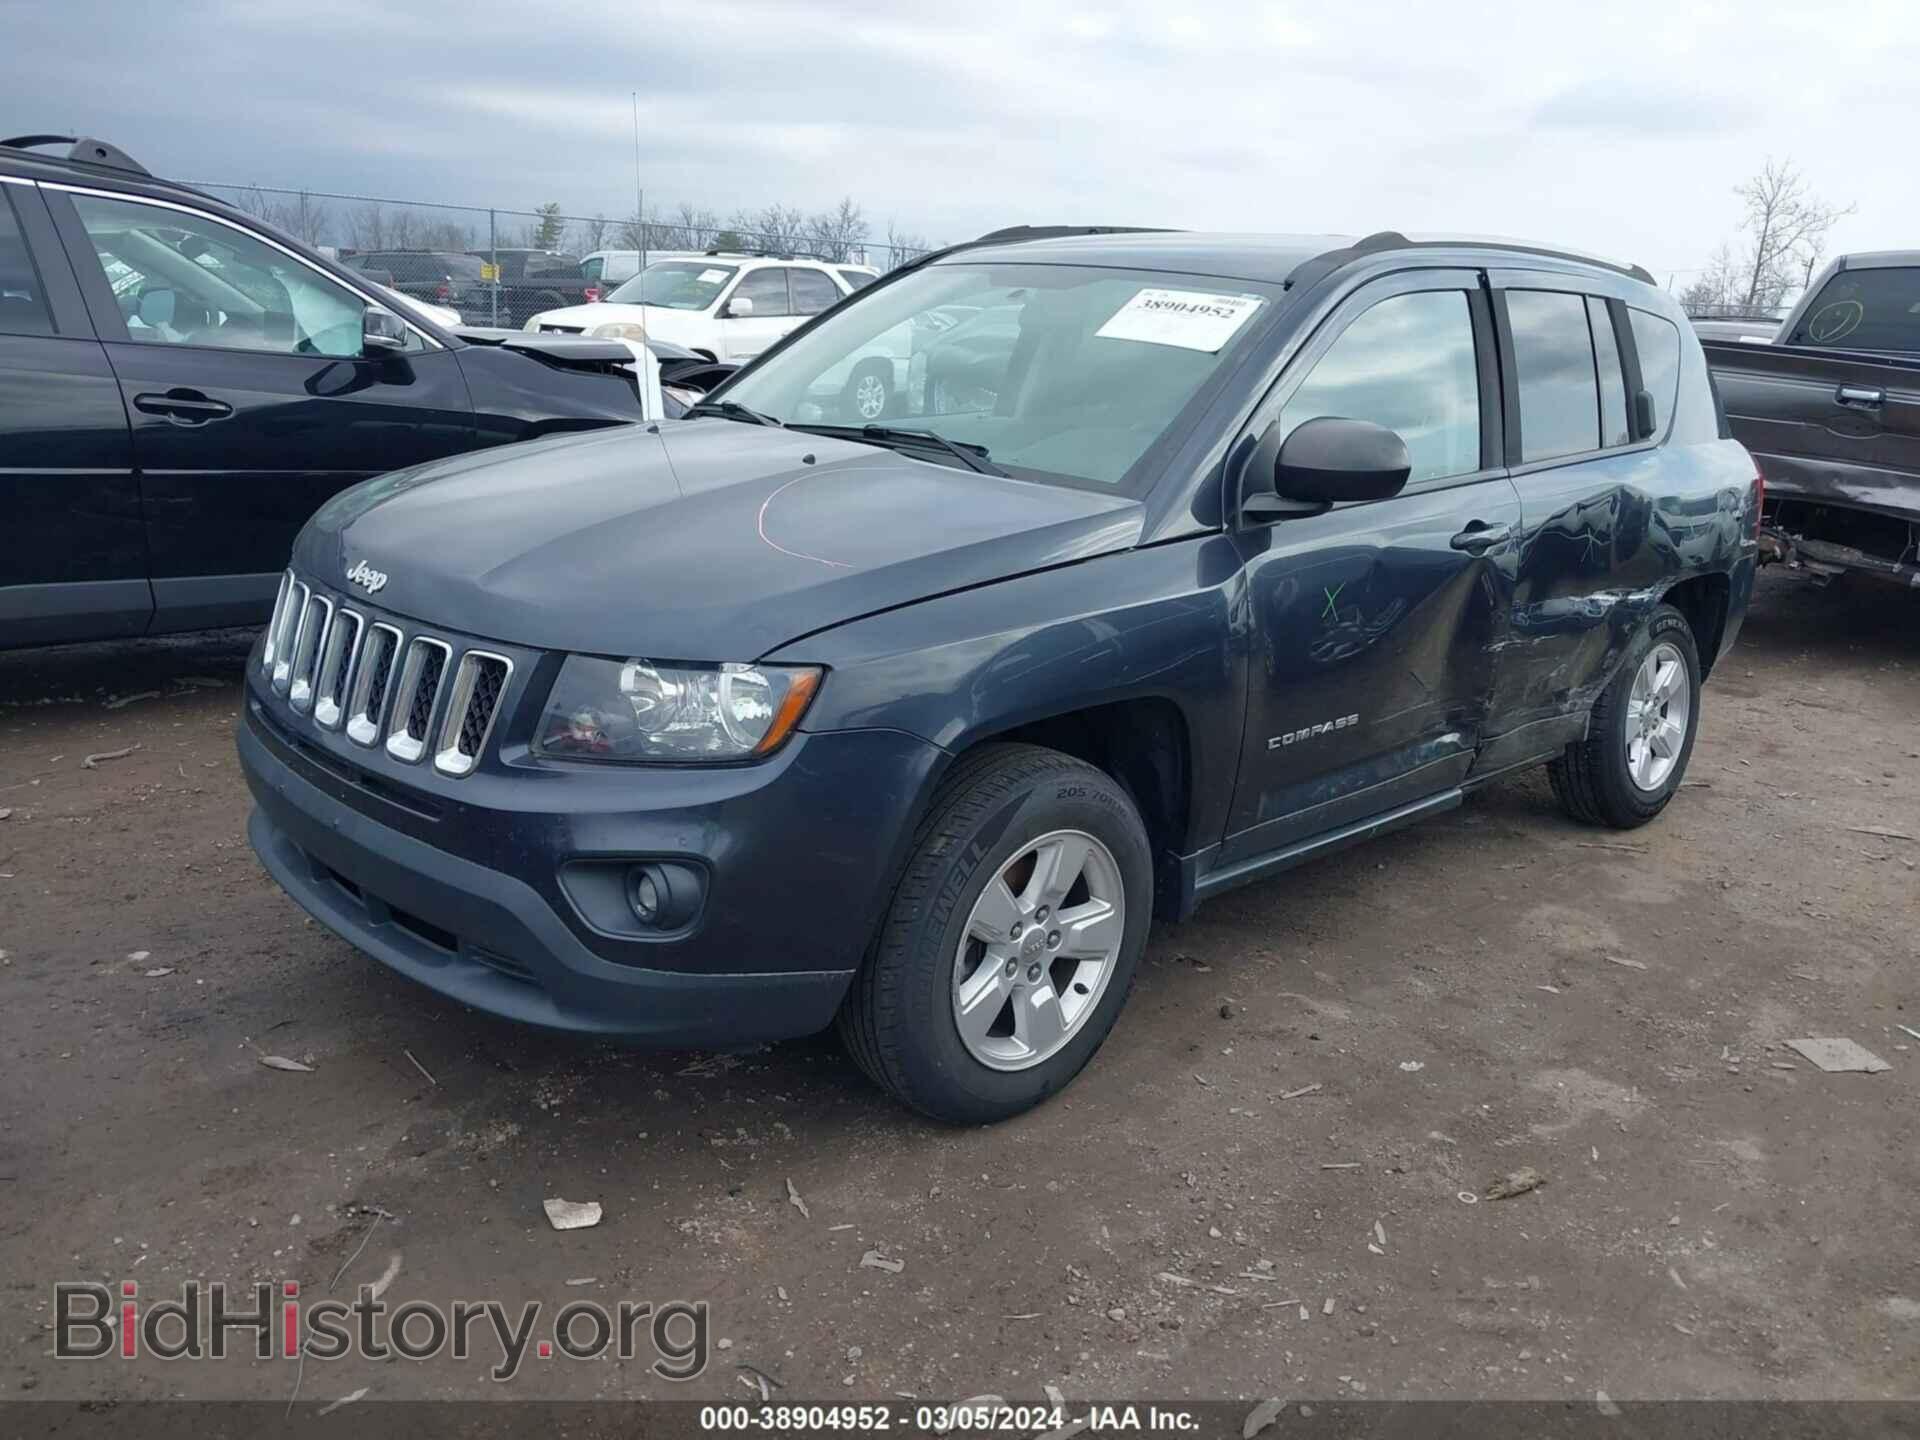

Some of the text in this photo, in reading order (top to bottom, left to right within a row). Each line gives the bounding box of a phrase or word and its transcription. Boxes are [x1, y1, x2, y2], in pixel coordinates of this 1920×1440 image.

[1136, 299, 1236, 319] 38904952
[347, 560, 388, 594] Jeep
[1268, 713, 1359, 750] COMPASS
[1056, 786, 1088, 799] 205
